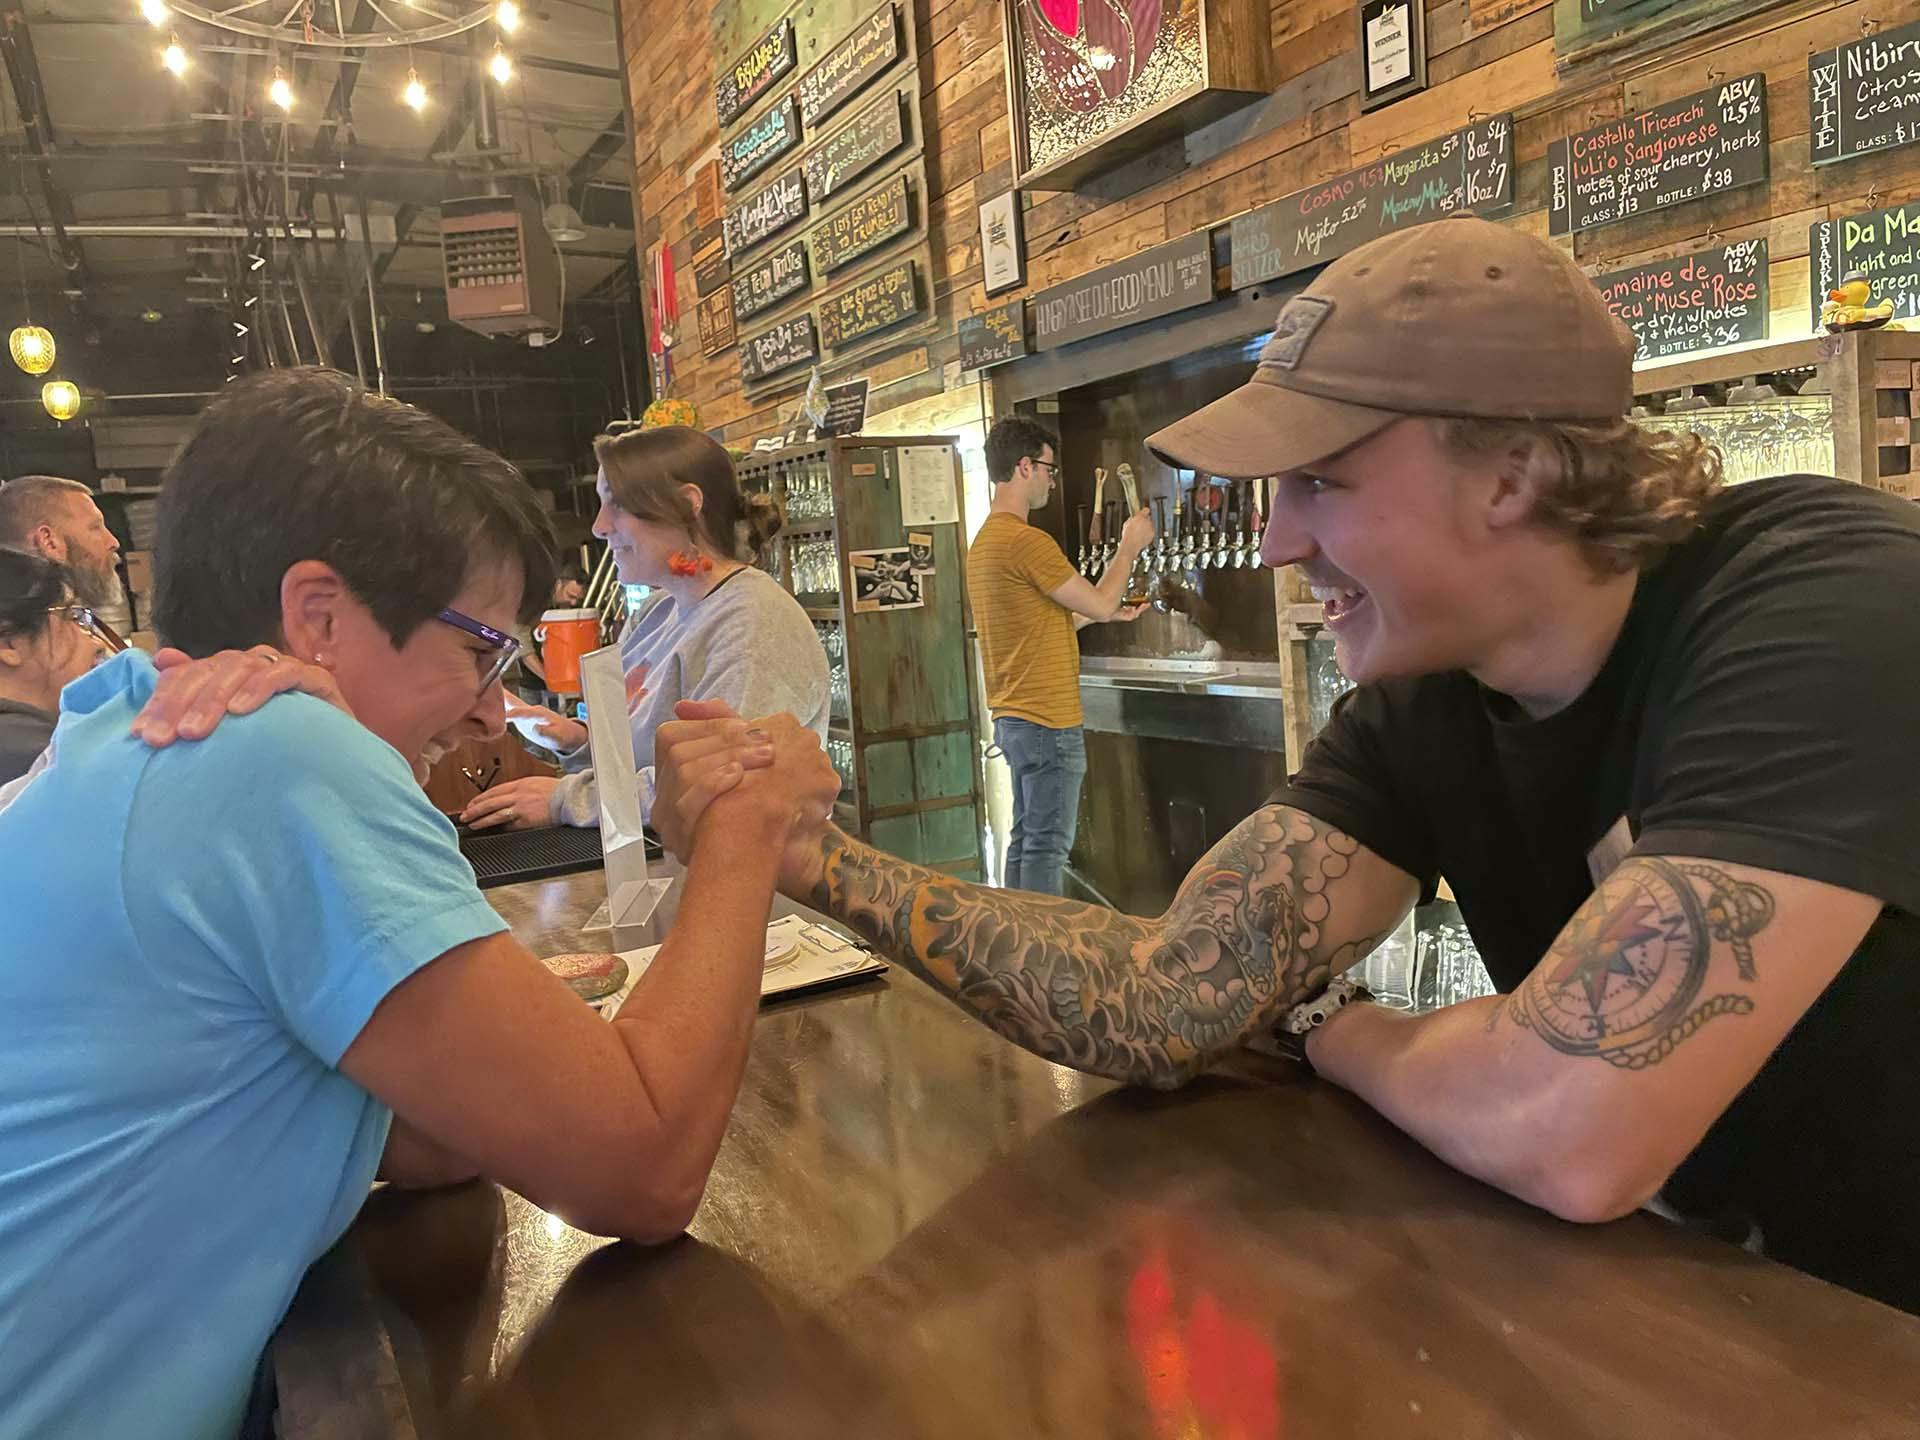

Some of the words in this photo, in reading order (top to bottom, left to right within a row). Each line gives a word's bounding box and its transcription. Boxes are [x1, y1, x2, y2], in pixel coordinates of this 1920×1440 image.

[1717, 79, 1755, 107] ABV
[1573, 123, 1635, 158] Castello
[1635, 99, 1704, 135] Tricerchi
[1625, 123, 1718, 164] Sangiovese
[1895, 121, 1920, 144] $1
[1384, 150, 1439, 187] Margarita
[1577, 174, 1613, 195] notes
[1617, 166, 1632, 187] of
[1721, 128, 1761, 153] herbs
[1581, 208, 1615, 226] GLASS:
[1616, 197, 1639, 218] $13
[1656, 187, 1697, 205] BOTTLE:
[1702, 168, 1733, 193] $38
[1589, 187, 1615, 206] and
[1620, 175, 1658, 202] fruit
[1723, 240, 1758, 260] ABV
[1845, 221, 1875, 252] Da
[1728, 256, 1757, 274] 12%
[1890, 246, 1912, 265] and
[1111, 273, 1139, 313] FOOD
[1602, 271, 1674, 303] omaine
[1680, 257, 1710, 282] de
[1871, 274, 1918, 299] green
[1660, 339, 1700, 355] BOTTLE:
[1702, 323, 1740, 347] $36
[1664, 320, 1710, 341] melon
